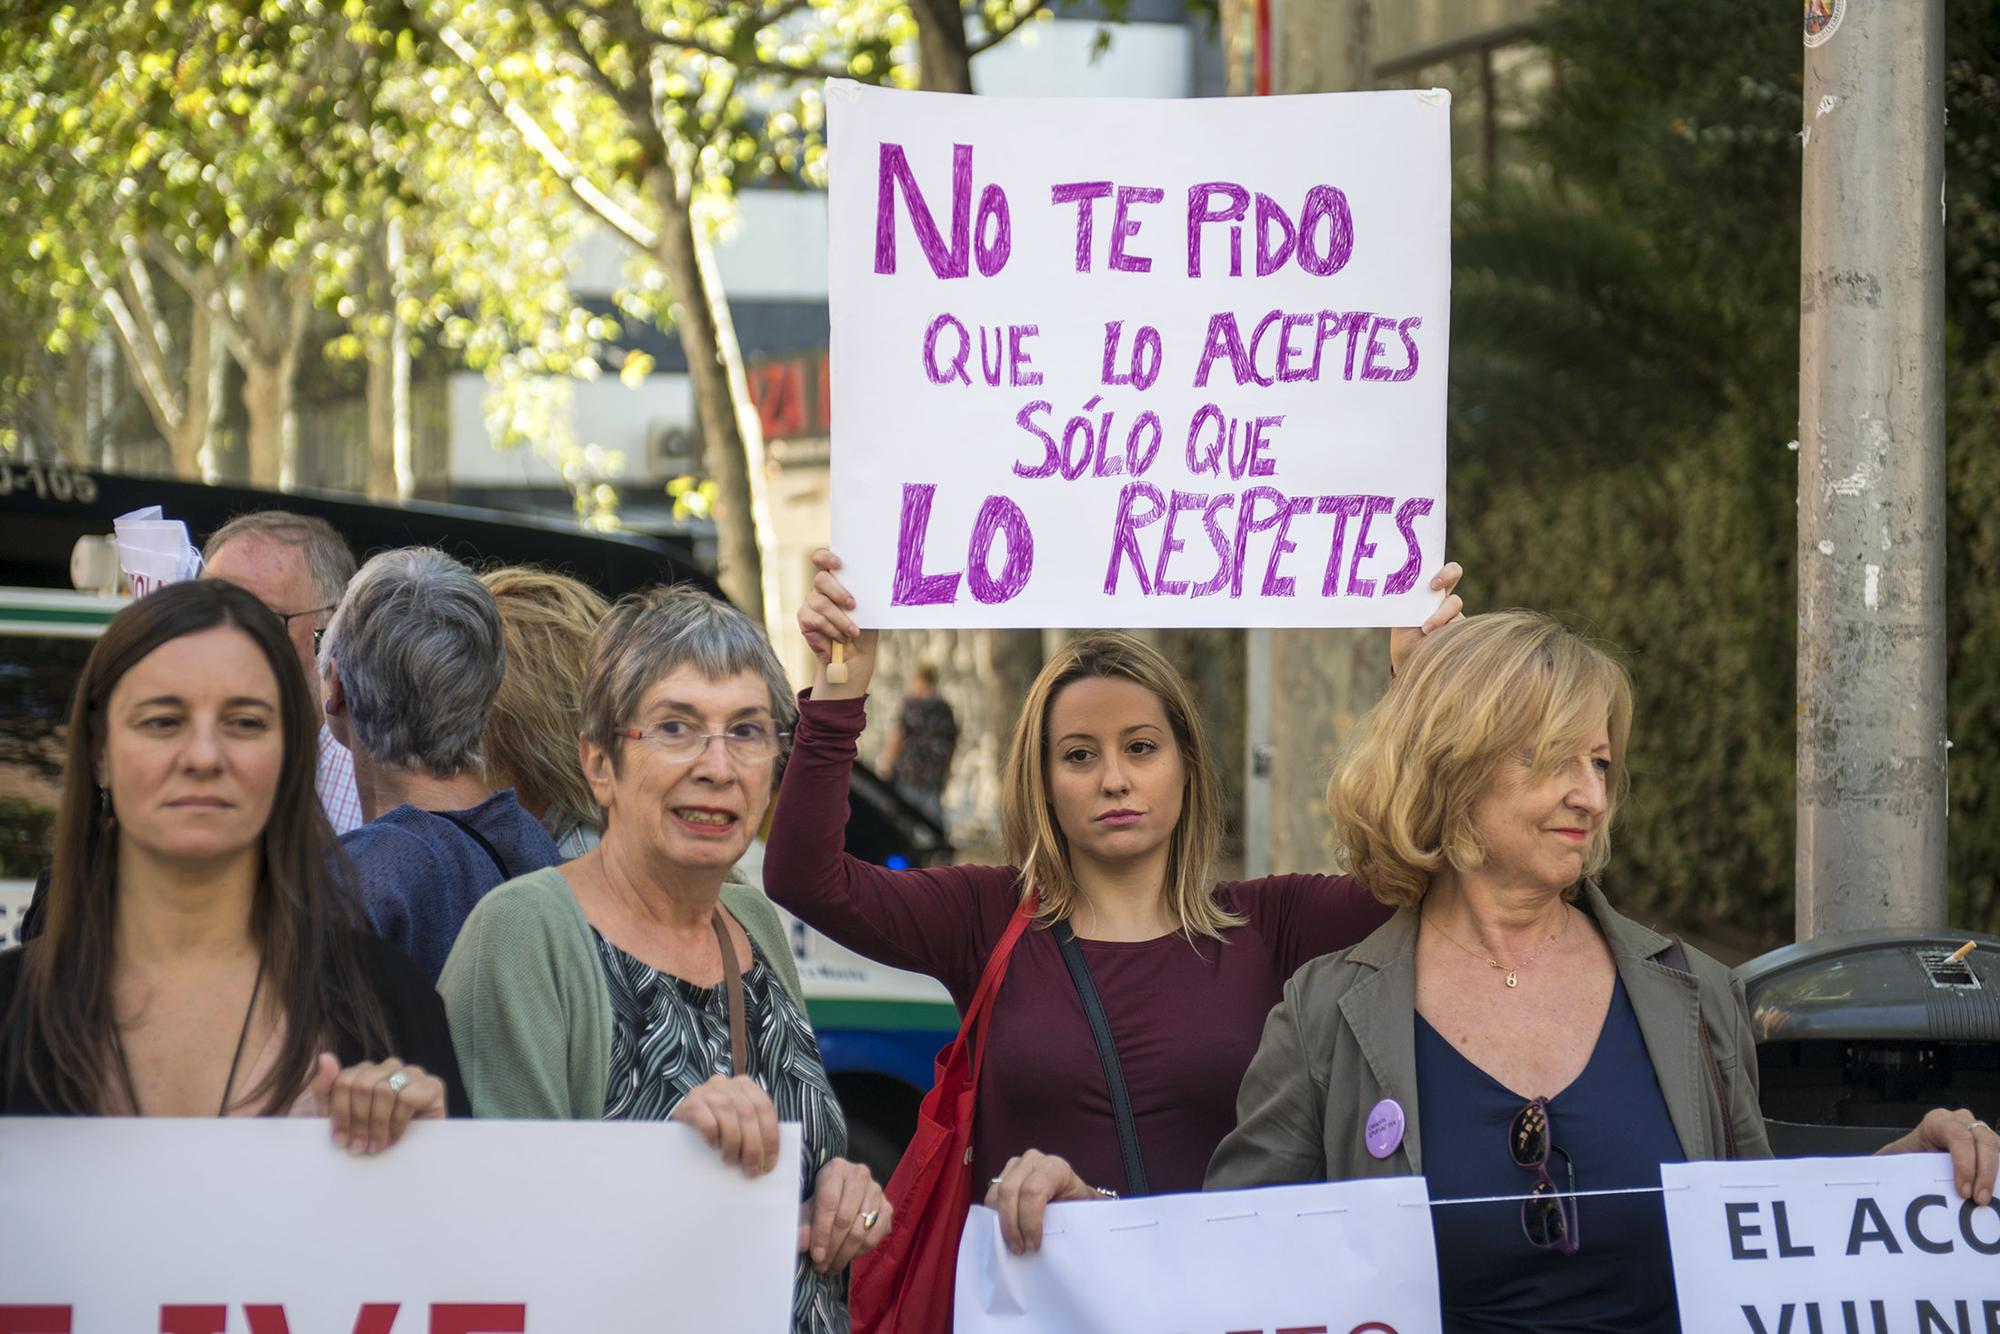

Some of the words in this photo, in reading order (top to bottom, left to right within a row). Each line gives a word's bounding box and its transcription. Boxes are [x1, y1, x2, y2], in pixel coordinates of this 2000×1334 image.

[874, 143, 1012, 280] NO
[1051, 181, 1165, 273] TE
[922, 312, 1044, 388] QUE
[1101, 319, 1163, 391] LO
[1193, 309, 1423, 388] ACEPTES
[1012, 395, 1164, 481] SÓLO
[1185, 403, 1287, 480] QUE
[890, 482, 1035, 608] LO
[1102, 481, 1435, 599] RESPETES
[1724, 1200, 1816, 1261] EL
